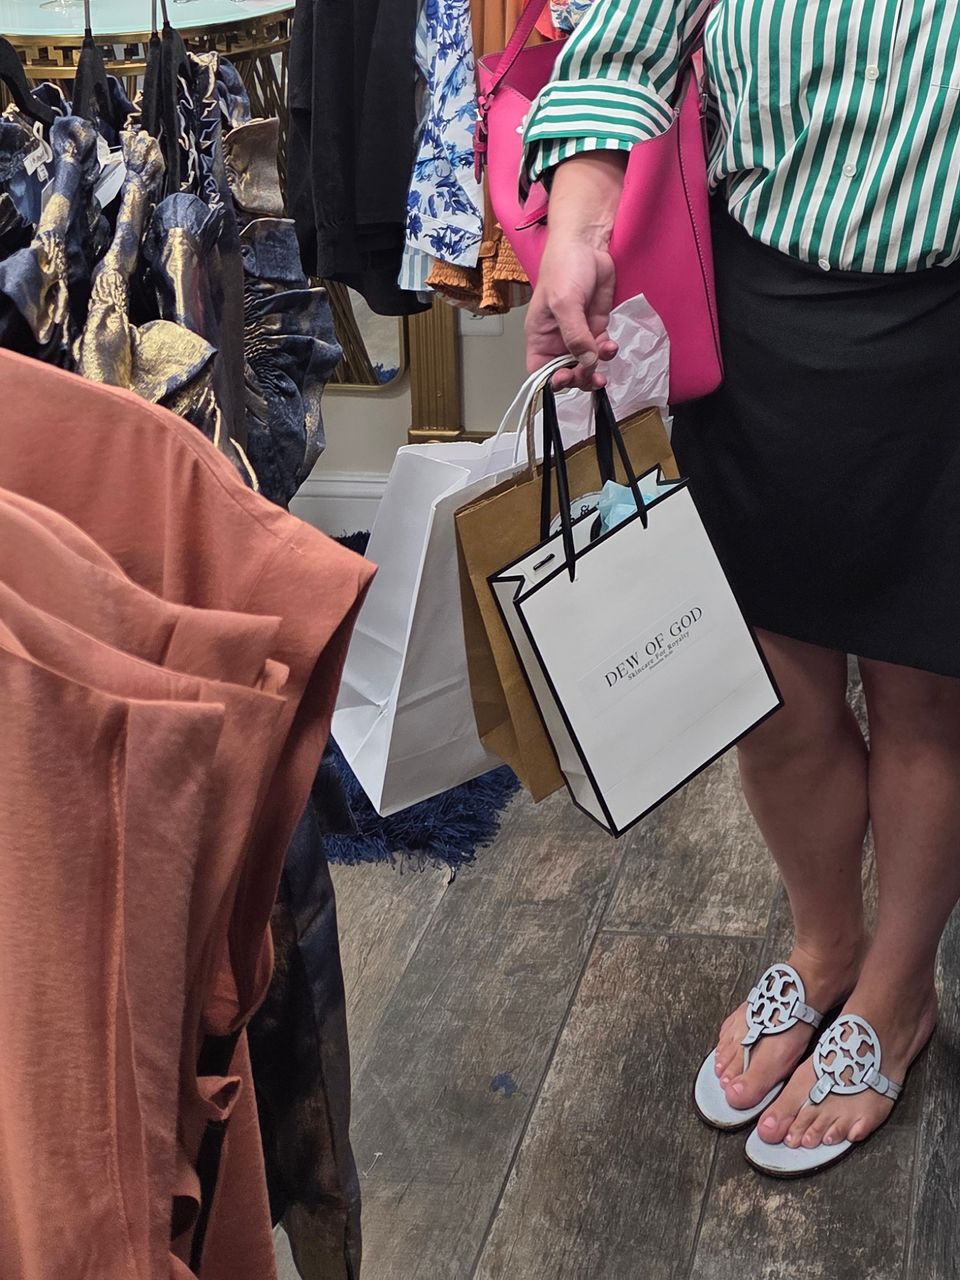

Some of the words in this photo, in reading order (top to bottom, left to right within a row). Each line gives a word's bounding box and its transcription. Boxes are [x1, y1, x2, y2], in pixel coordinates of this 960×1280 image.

[604, 651, 639, 687] DEW
[645, 633, 664, 655] OF
[669, 607, 703, 637] GOD
[627, 659, 654, 680] Skincare
[655, 649, 666, 660] For
[667, 631, 690, 650] Royalty
